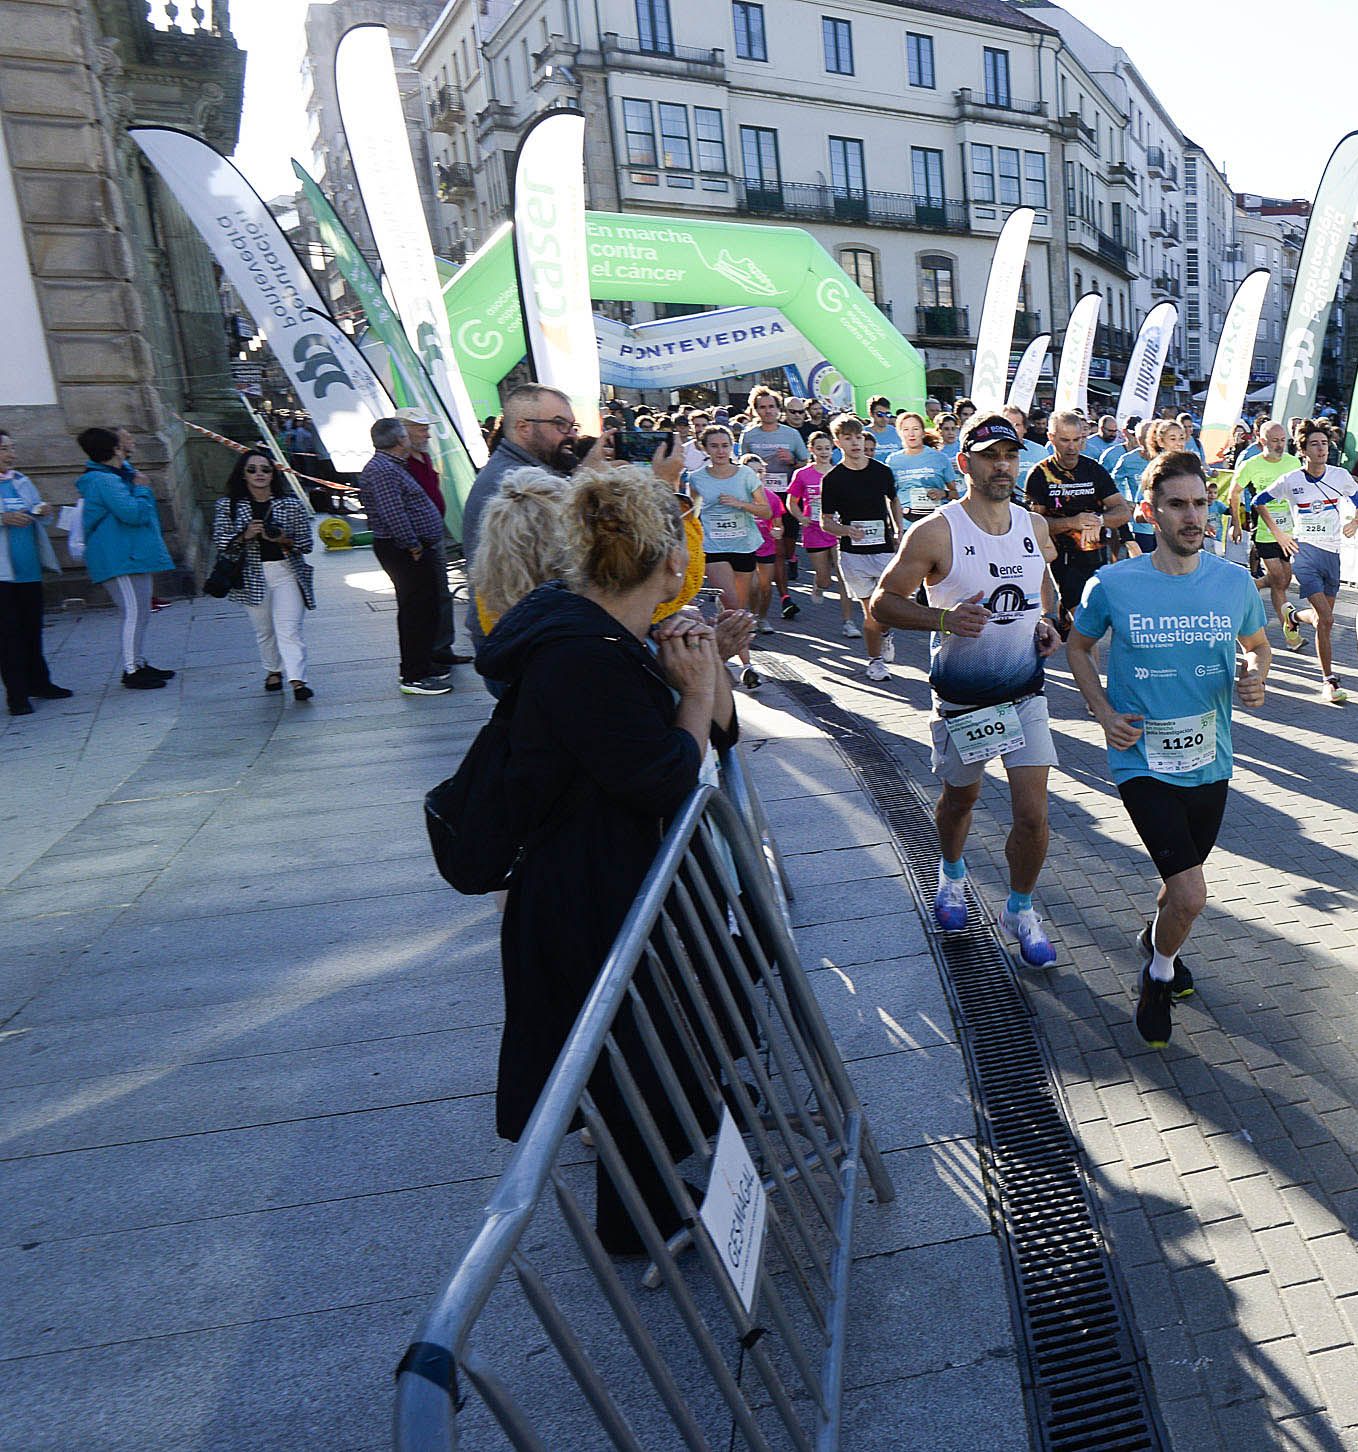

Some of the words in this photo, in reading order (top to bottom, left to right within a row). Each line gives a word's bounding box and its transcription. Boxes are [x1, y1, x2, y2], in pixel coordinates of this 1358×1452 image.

[524, 168, 567, 317] caser
[587, 223, 613, 238] En
[616, 225, 693, 244] marcha
[591, 244, 658, 261] contra
[591, 262, 613, 277] el
[616, 262, 687, 281] cáncer
[619, 321, 785, 360] PONTEVEDRA
[1134, 337, 1159, 402] nugape
[1061, 487, 1095, 496] INFERNO
[1306, 523, 1326, 532] 2284
[999, 564, 1023, 575] ence
[1129, 613, 1157, 631] En
[1159, 611, 1232, 629] marcha
[966, 721, 1006, 742] 1109
[1162, 733, 1204, 750] 1120
